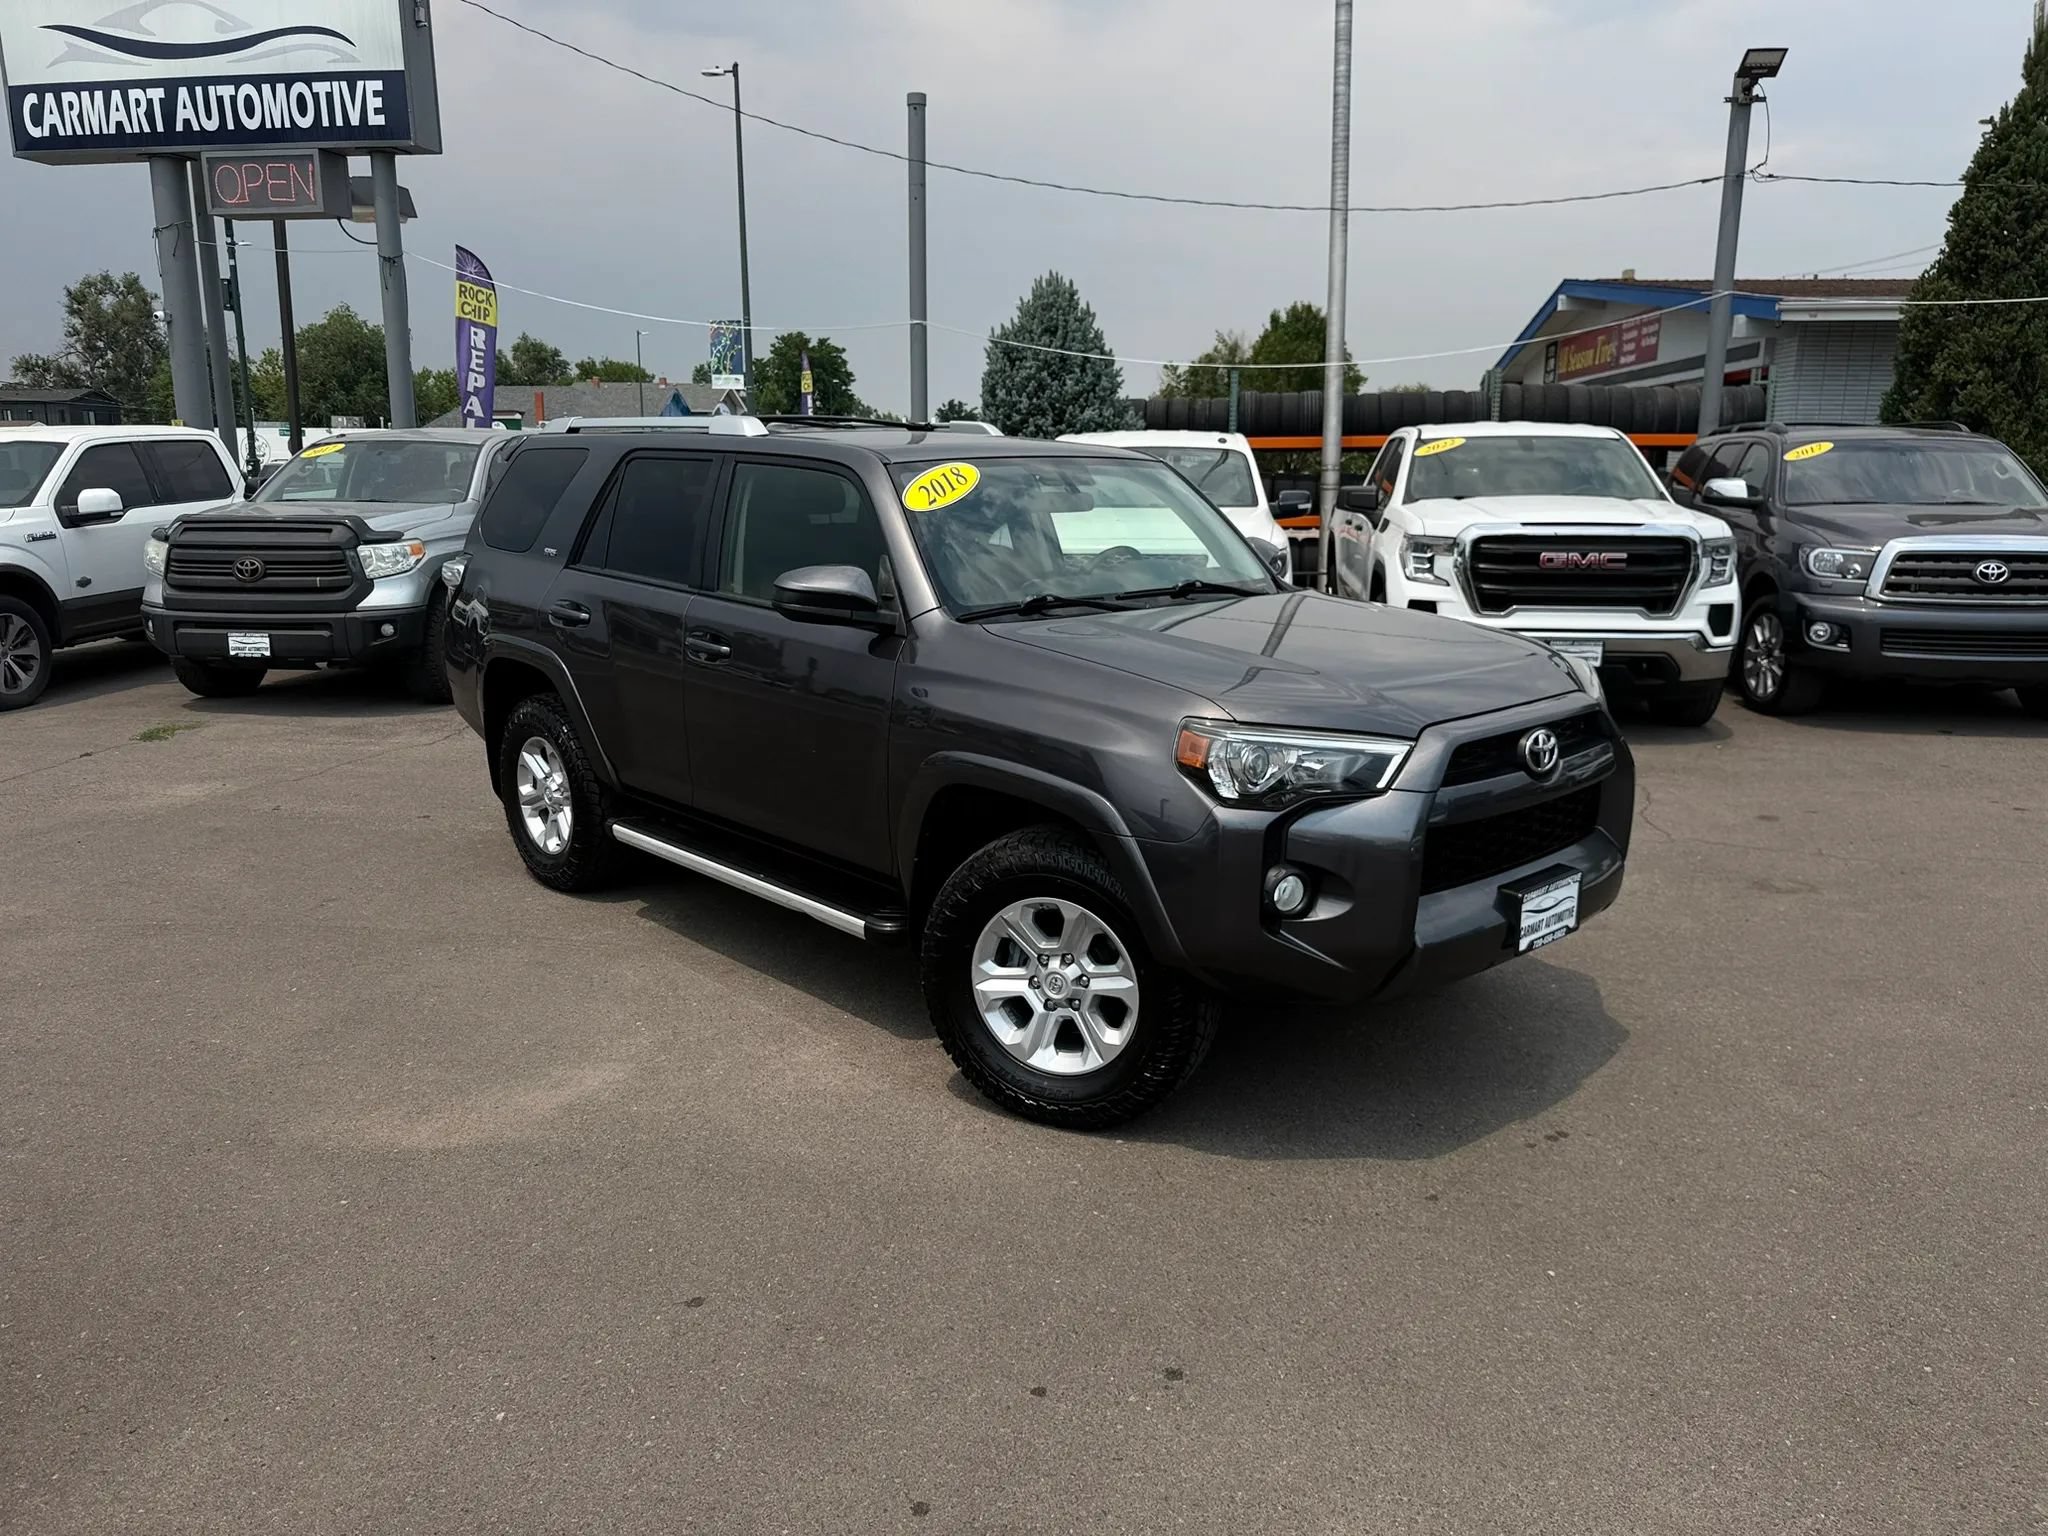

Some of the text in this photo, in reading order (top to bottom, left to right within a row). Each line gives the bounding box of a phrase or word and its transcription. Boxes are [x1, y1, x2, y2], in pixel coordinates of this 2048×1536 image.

[23, 79, 386, 138] CARMART AUTOMOTIVE
[215, 163, 315, 203] OPEN
[458, 284, 493, 307] ROCK
[460, 301, 491, 321] CHIP
[918, 467, 968, 506] 2018
[1540, 552, 1628, 569] GMC
[1520, 918, 1545, 939] CARMART
[1544, 906, 1576, 928] AUTOMOTIVE
